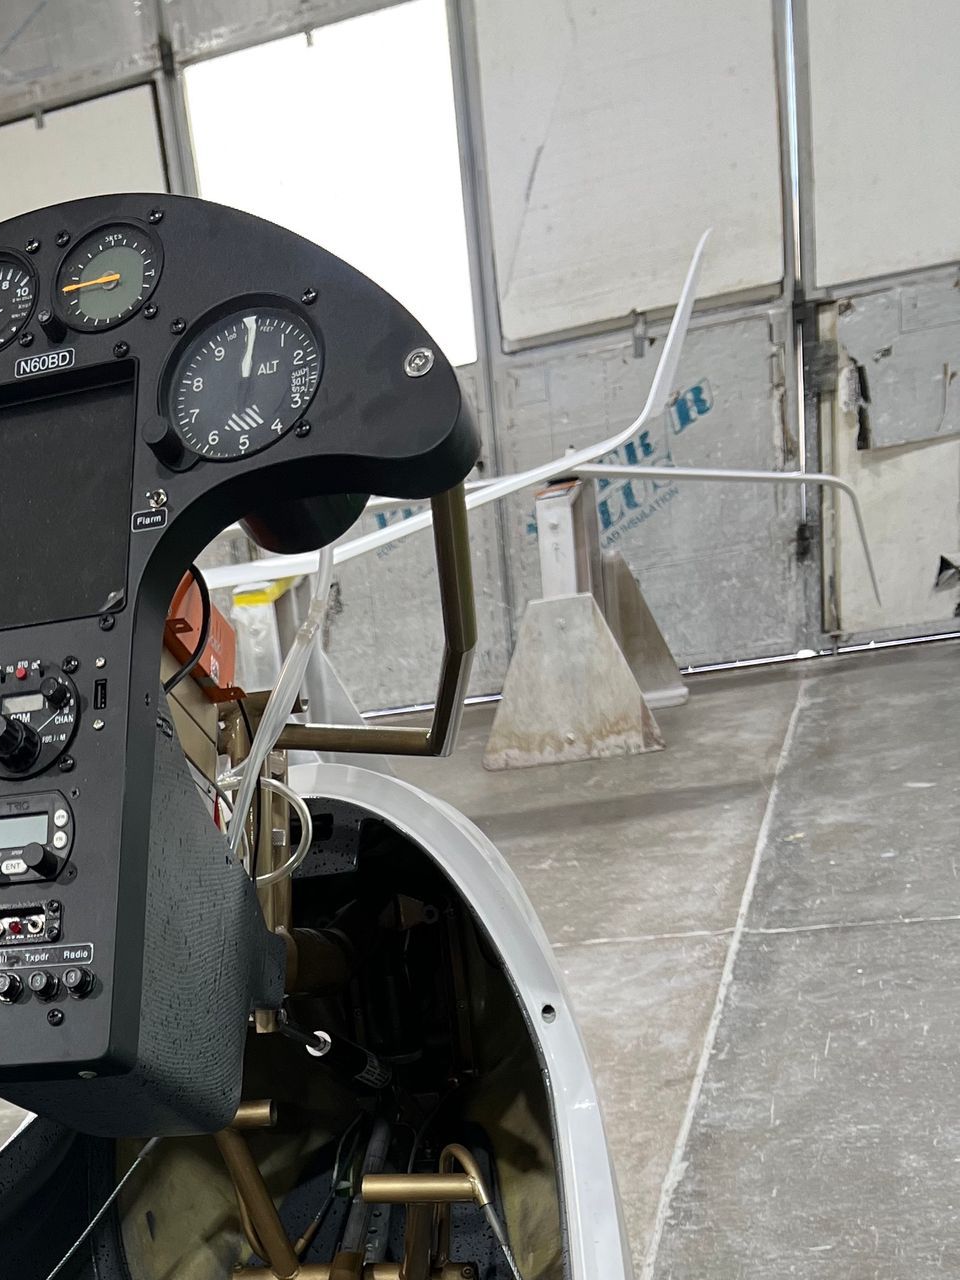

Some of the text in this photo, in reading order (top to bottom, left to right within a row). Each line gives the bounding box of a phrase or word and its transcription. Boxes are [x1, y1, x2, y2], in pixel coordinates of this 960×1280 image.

[1, 281, 9, 290] 8
[16, 287, 29, 297] 10
[214, 347, 225, 361] 9
[293, 350, 304, 365] 2
[20, 351, 70, 375] N60BD
[257, 360, 280, 376] ALT
[192, 377, 203, 392] 8
[290, 393, 301, 408] 3
[189, 408, 200, 423] 7
[270, 418, 283, 435] 4
[208, 430, 219, 445] 6
[239, 434, 250, 450] 5
[136, 515, 162, 526] Flarm
[54, 714, 74, 725] CHAN
[5, 862, 21, 871] ENT
[24, 953, 50, 963] Txpdr
[63, 949, 89, 960] Radio
[70, 973, 76, 983] 3
